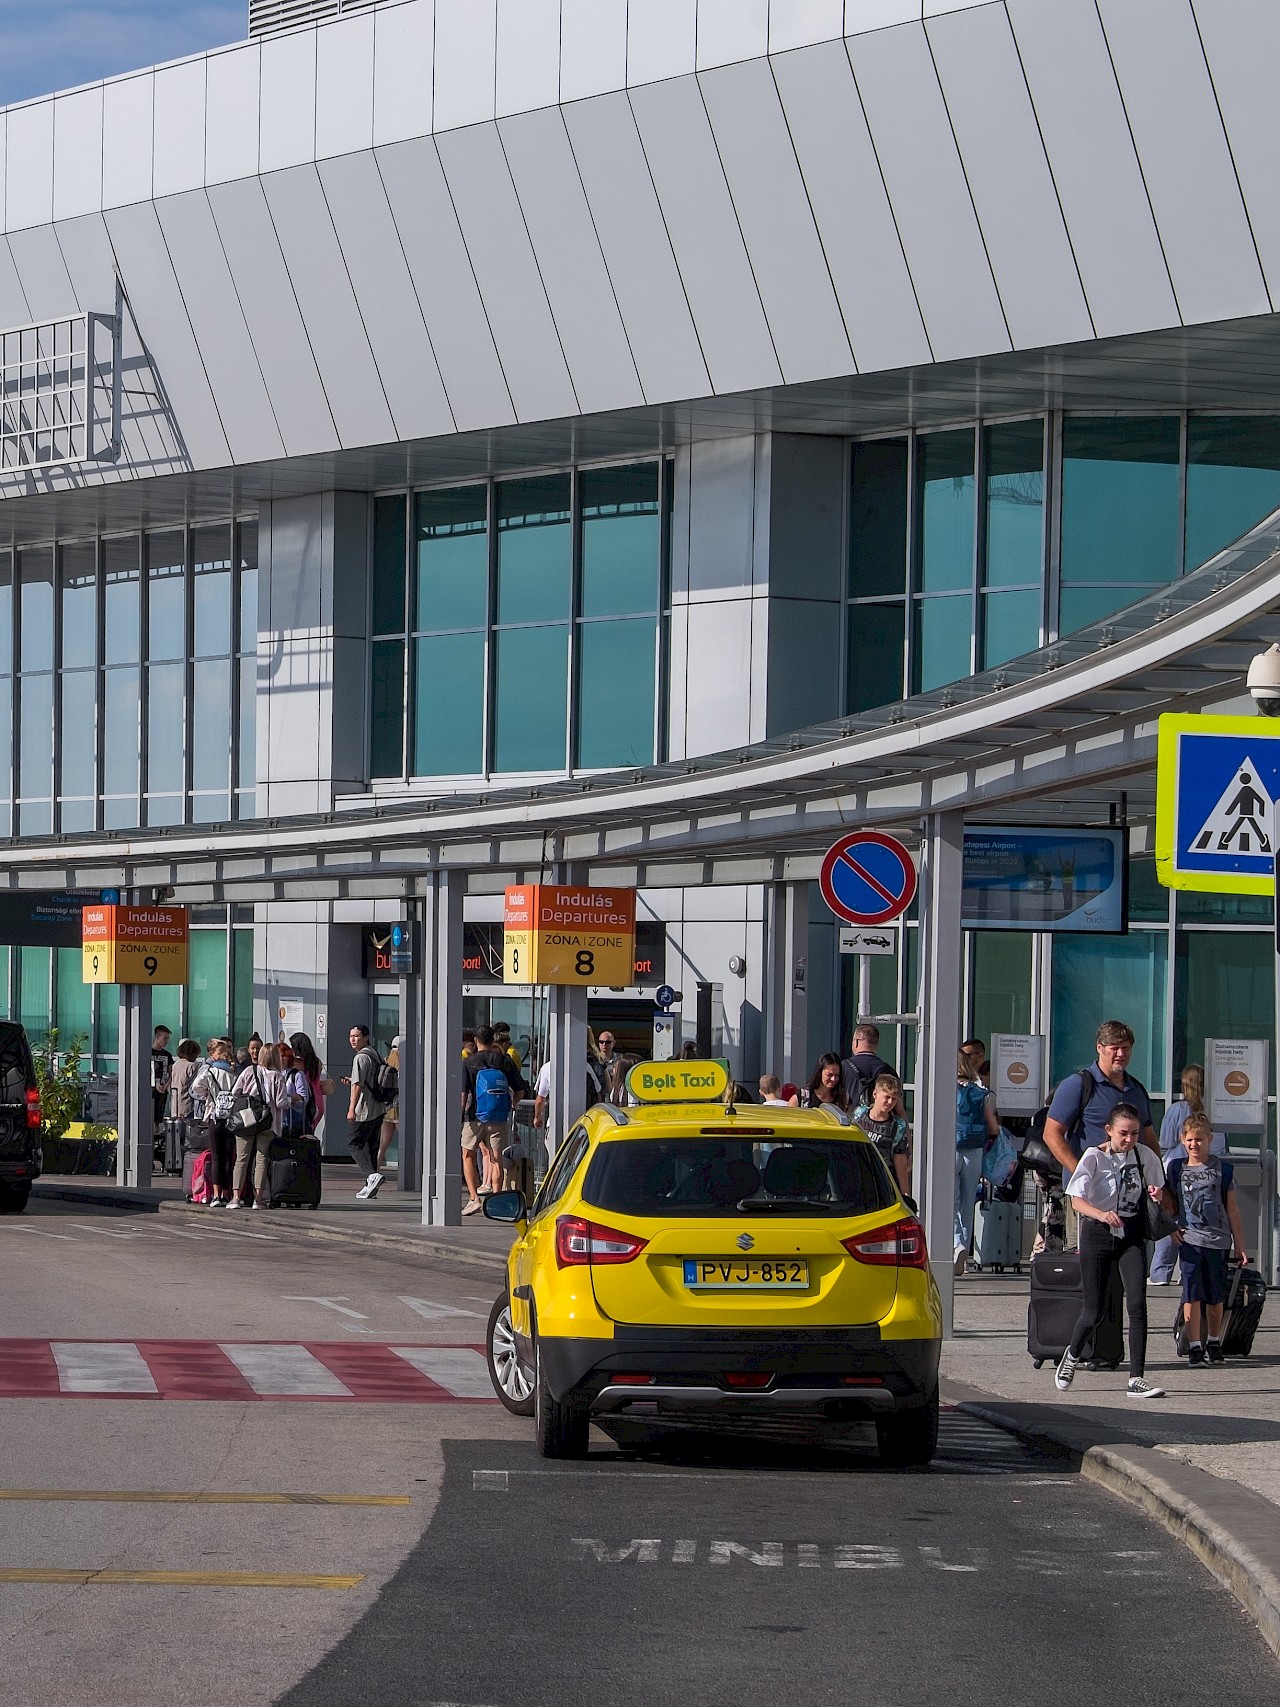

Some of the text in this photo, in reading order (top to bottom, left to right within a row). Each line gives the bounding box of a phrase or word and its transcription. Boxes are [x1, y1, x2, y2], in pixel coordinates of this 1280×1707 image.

[963, 841, 1016, 850] udapest Airport
[556, 892, 613, 908] Indulás
[128, 911, 173, 923] Indulás
[541, 908, 627, 925] Departures
[1087, 915, 1102, 924] bud
[118, 923, 183, 937] Departures
[120, 943, 181, 955] ZÓNA ZONE
[545, 933, 623, 948] ZÓNA ZONE
[93, 955, 99, 976] 9
[143, 956, 158, 977] 9
[376, 950, 392, 969] bu
[513, 948, 519, 974] 8
[574, 950, 595, 976] 8
[642, 1071, 715, 1092] Bolt Taxi
[701, 1263, 802, 1283] PVJ-852
